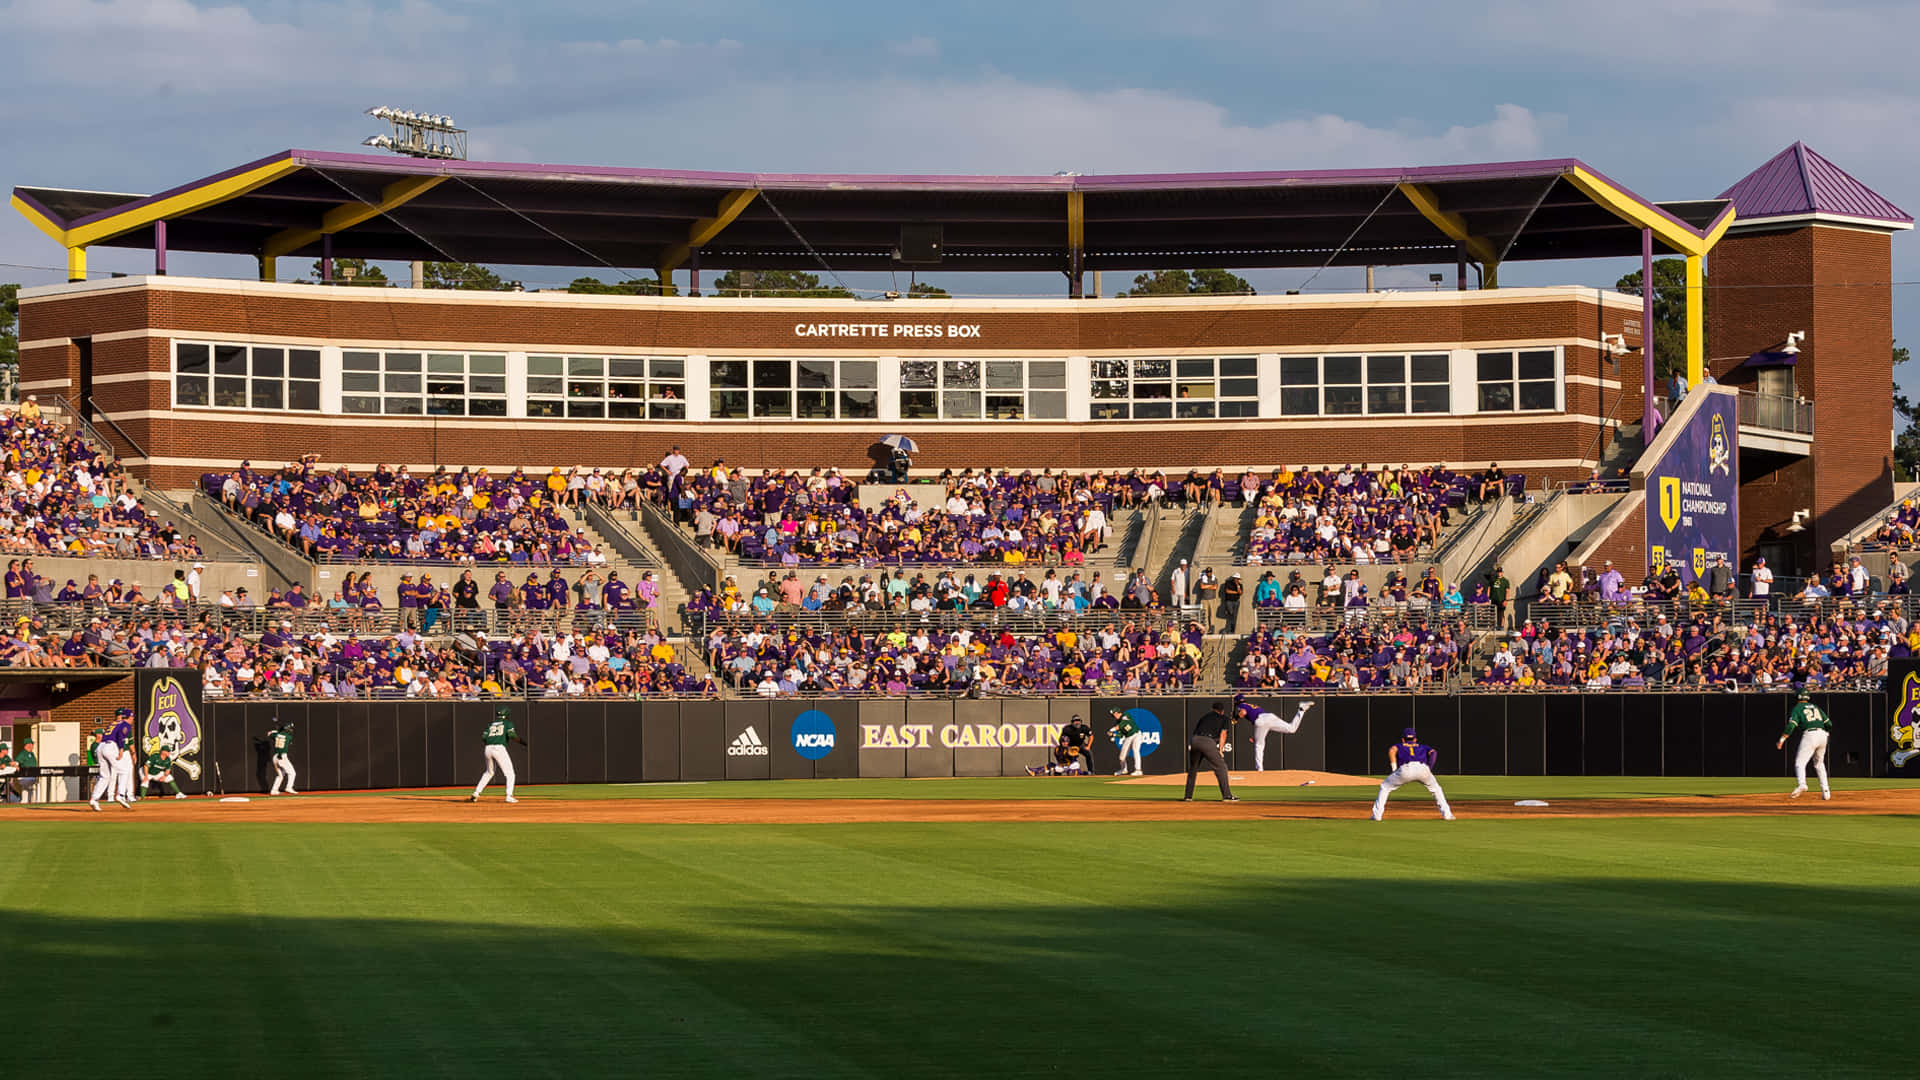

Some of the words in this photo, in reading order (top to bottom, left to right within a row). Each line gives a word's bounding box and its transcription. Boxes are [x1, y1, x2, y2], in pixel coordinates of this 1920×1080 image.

[795, 324, 888, 337] CARTRETTE
[893, 324, 943, 337] PRESS
[947, 325, 981, 338] BOX
[1682, 481, 1712, 497] NATIONAL
[1666, 484, 1673, 519] 1
[1682, 499, 1727, 515] CHAMPIONSHIP
[158, 694, 177, 710] ECU
[796, 734, 834, 747] NCAA
[862, 724, 933, 748] EAST
[940, 723, 1067, 748] CAROLIN
[727, 744, 769, 756] adidas
